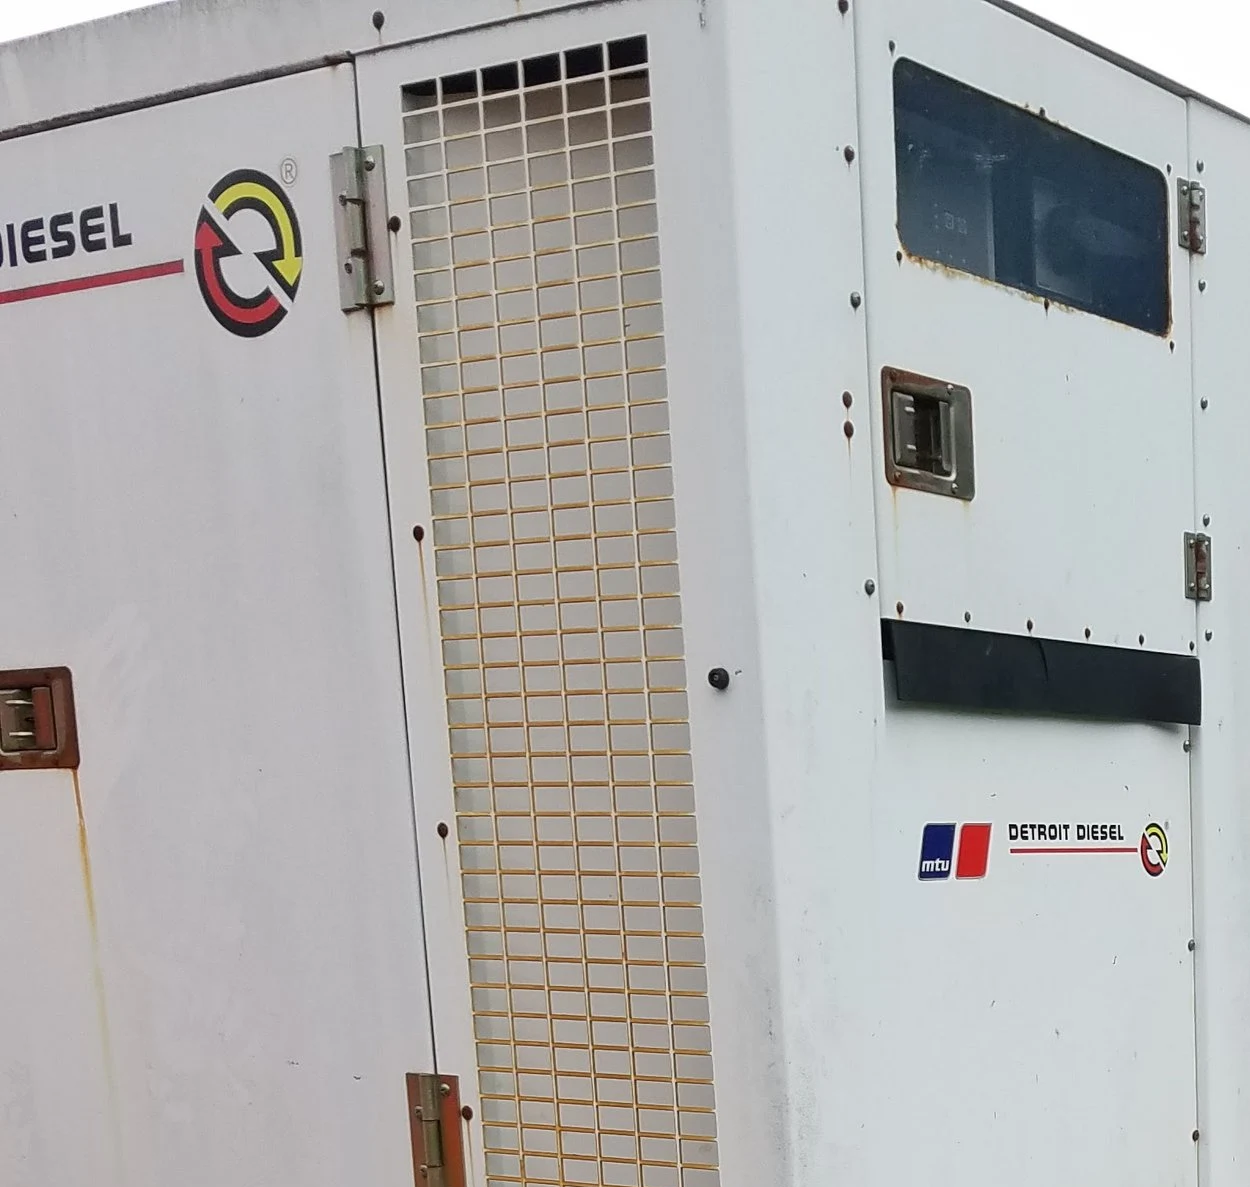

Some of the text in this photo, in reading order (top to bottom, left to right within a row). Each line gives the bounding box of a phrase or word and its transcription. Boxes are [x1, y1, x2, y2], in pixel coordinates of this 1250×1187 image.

[0, 202, 133, 268] IESEL
[1008, 824, 1125, 841] DETROIT DIESEL
[921, 857, 950, 873] mtu
